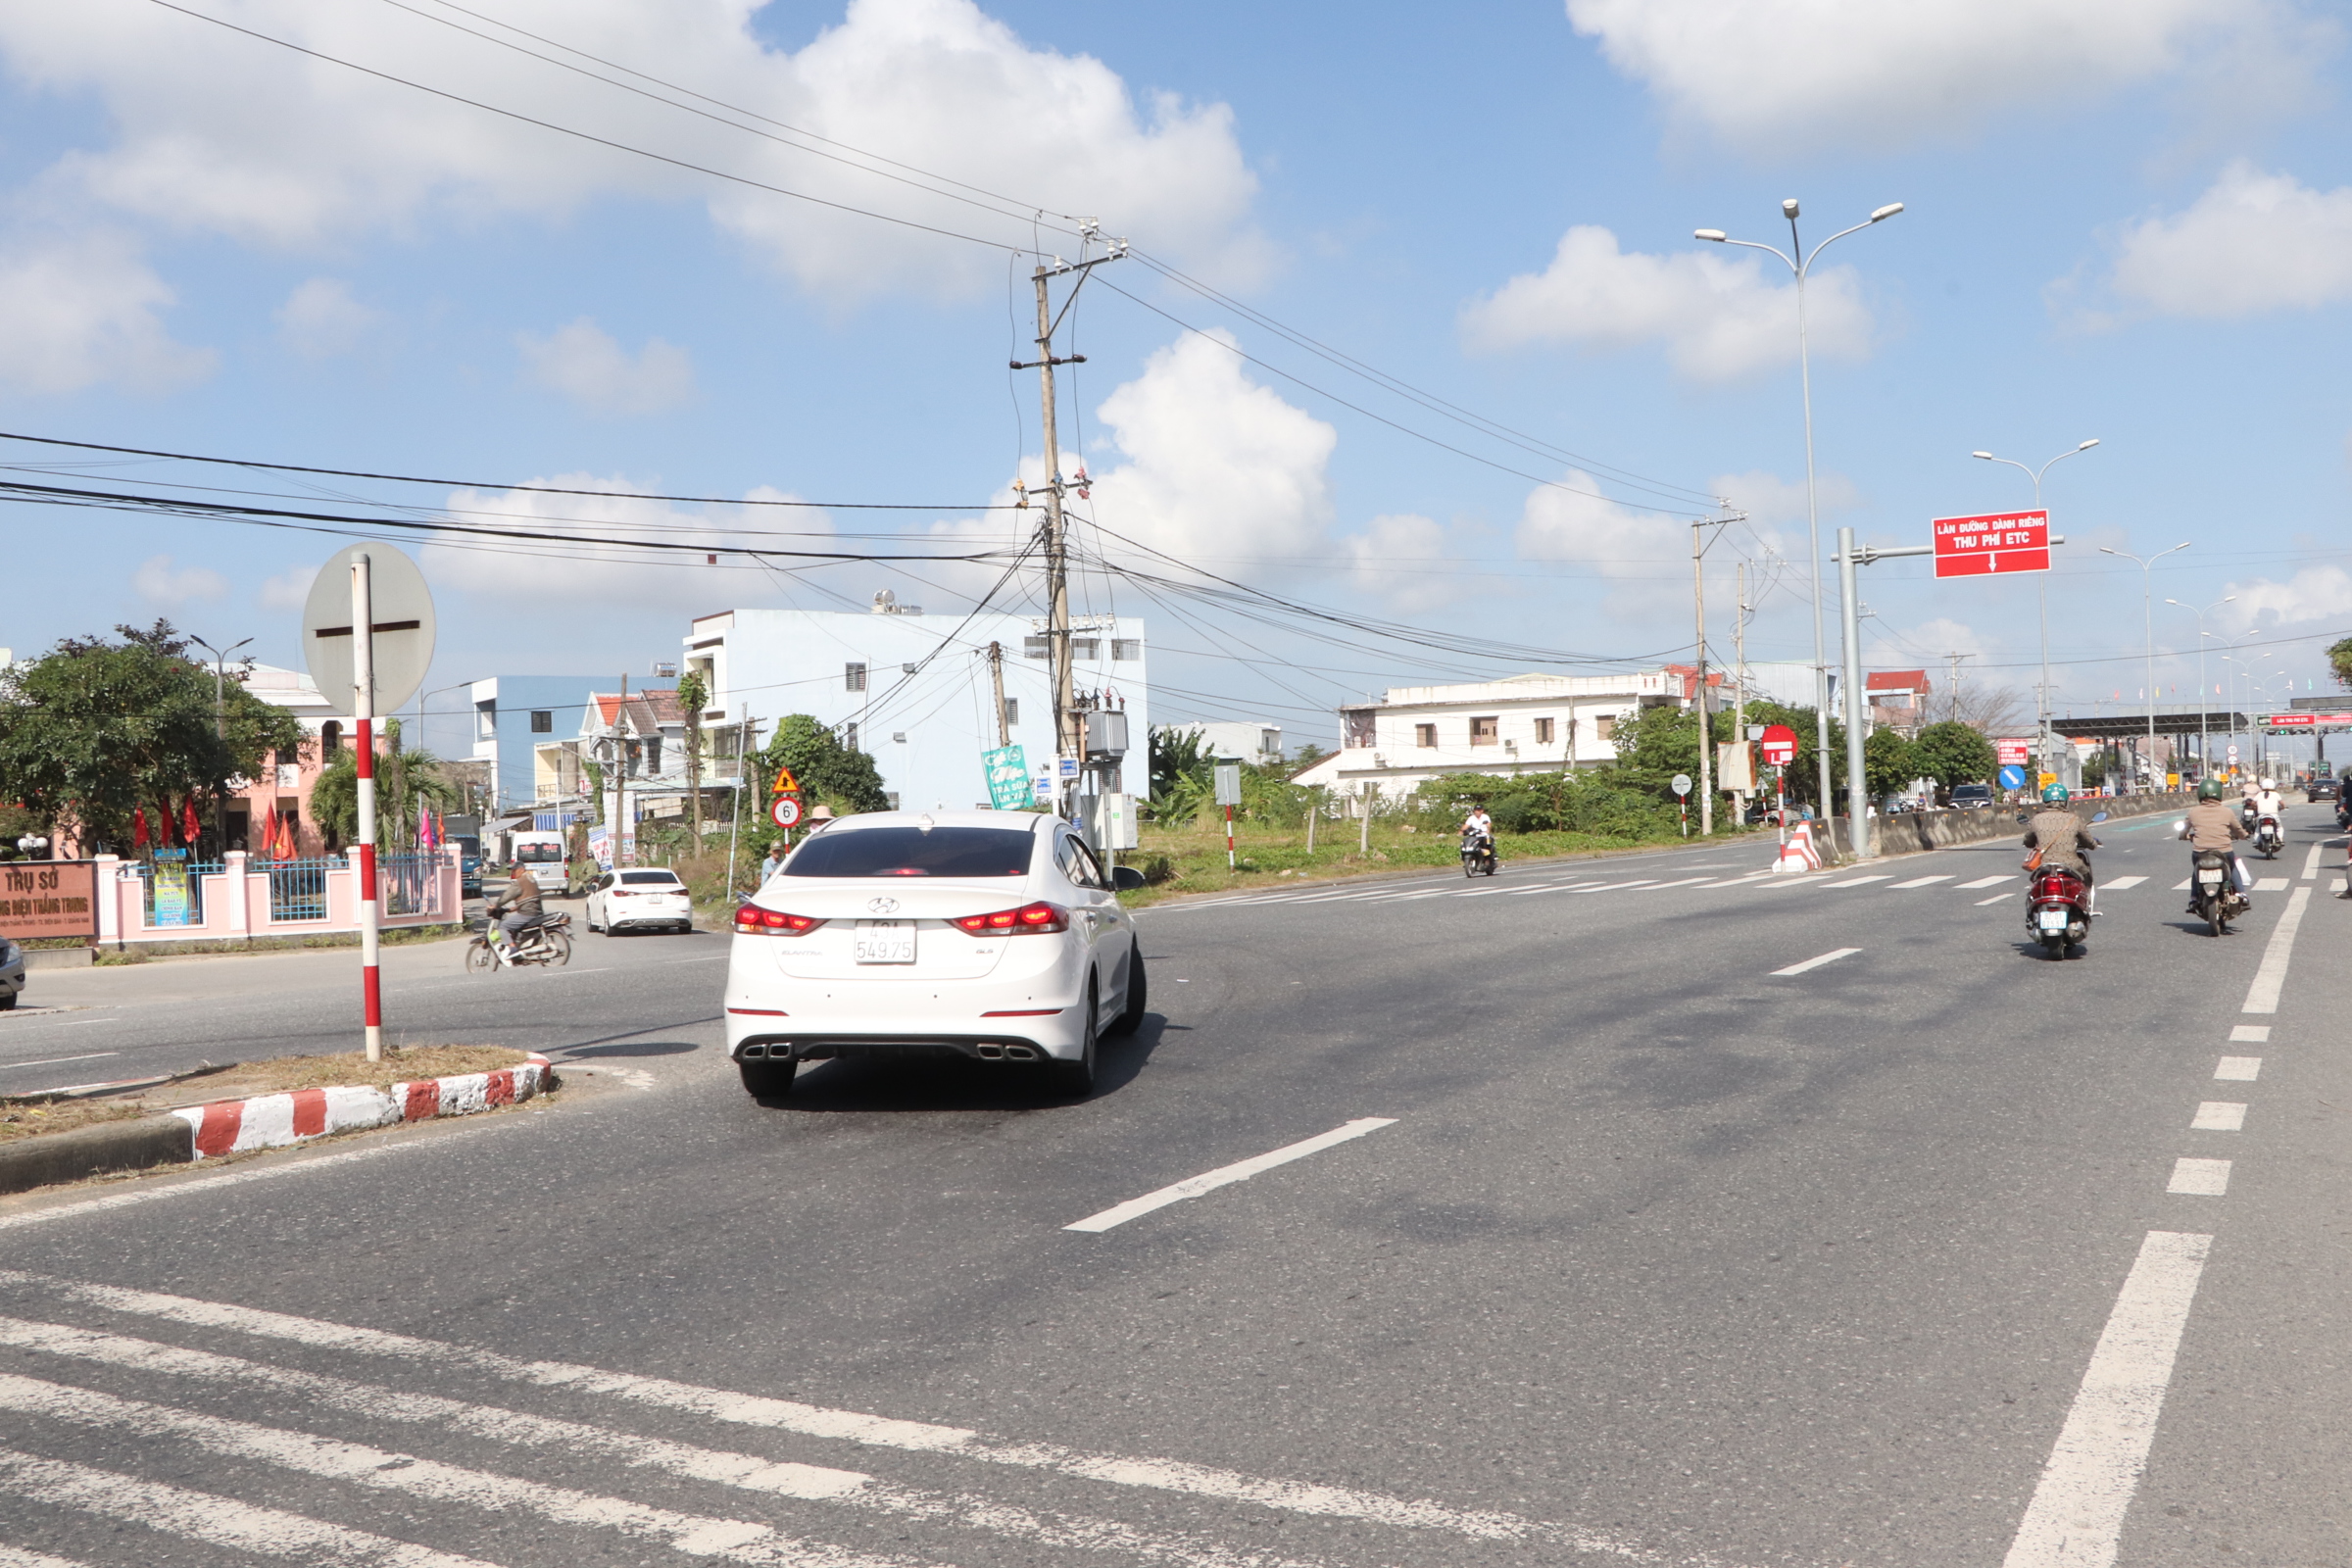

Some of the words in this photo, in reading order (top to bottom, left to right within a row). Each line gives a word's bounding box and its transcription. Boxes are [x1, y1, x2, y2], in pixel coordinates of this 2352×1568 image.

[1937, 522, 1956, 535] LÀN
[1992, 518, 2016, 530] DÀNH
[2019, 515, 2045, 528] RIÊNG
[1953, 536, 1977, 549] THU
[1982, 531, 2000, 547] PHÍ
[2006, 531, 2030, 544] ETC
[5, 871, 34, 894] TRỤ
[38, 865, 59, 890] SỞ
[869, 920, 901, 938] 43A
[857, 941, 911, 958] 549.75
